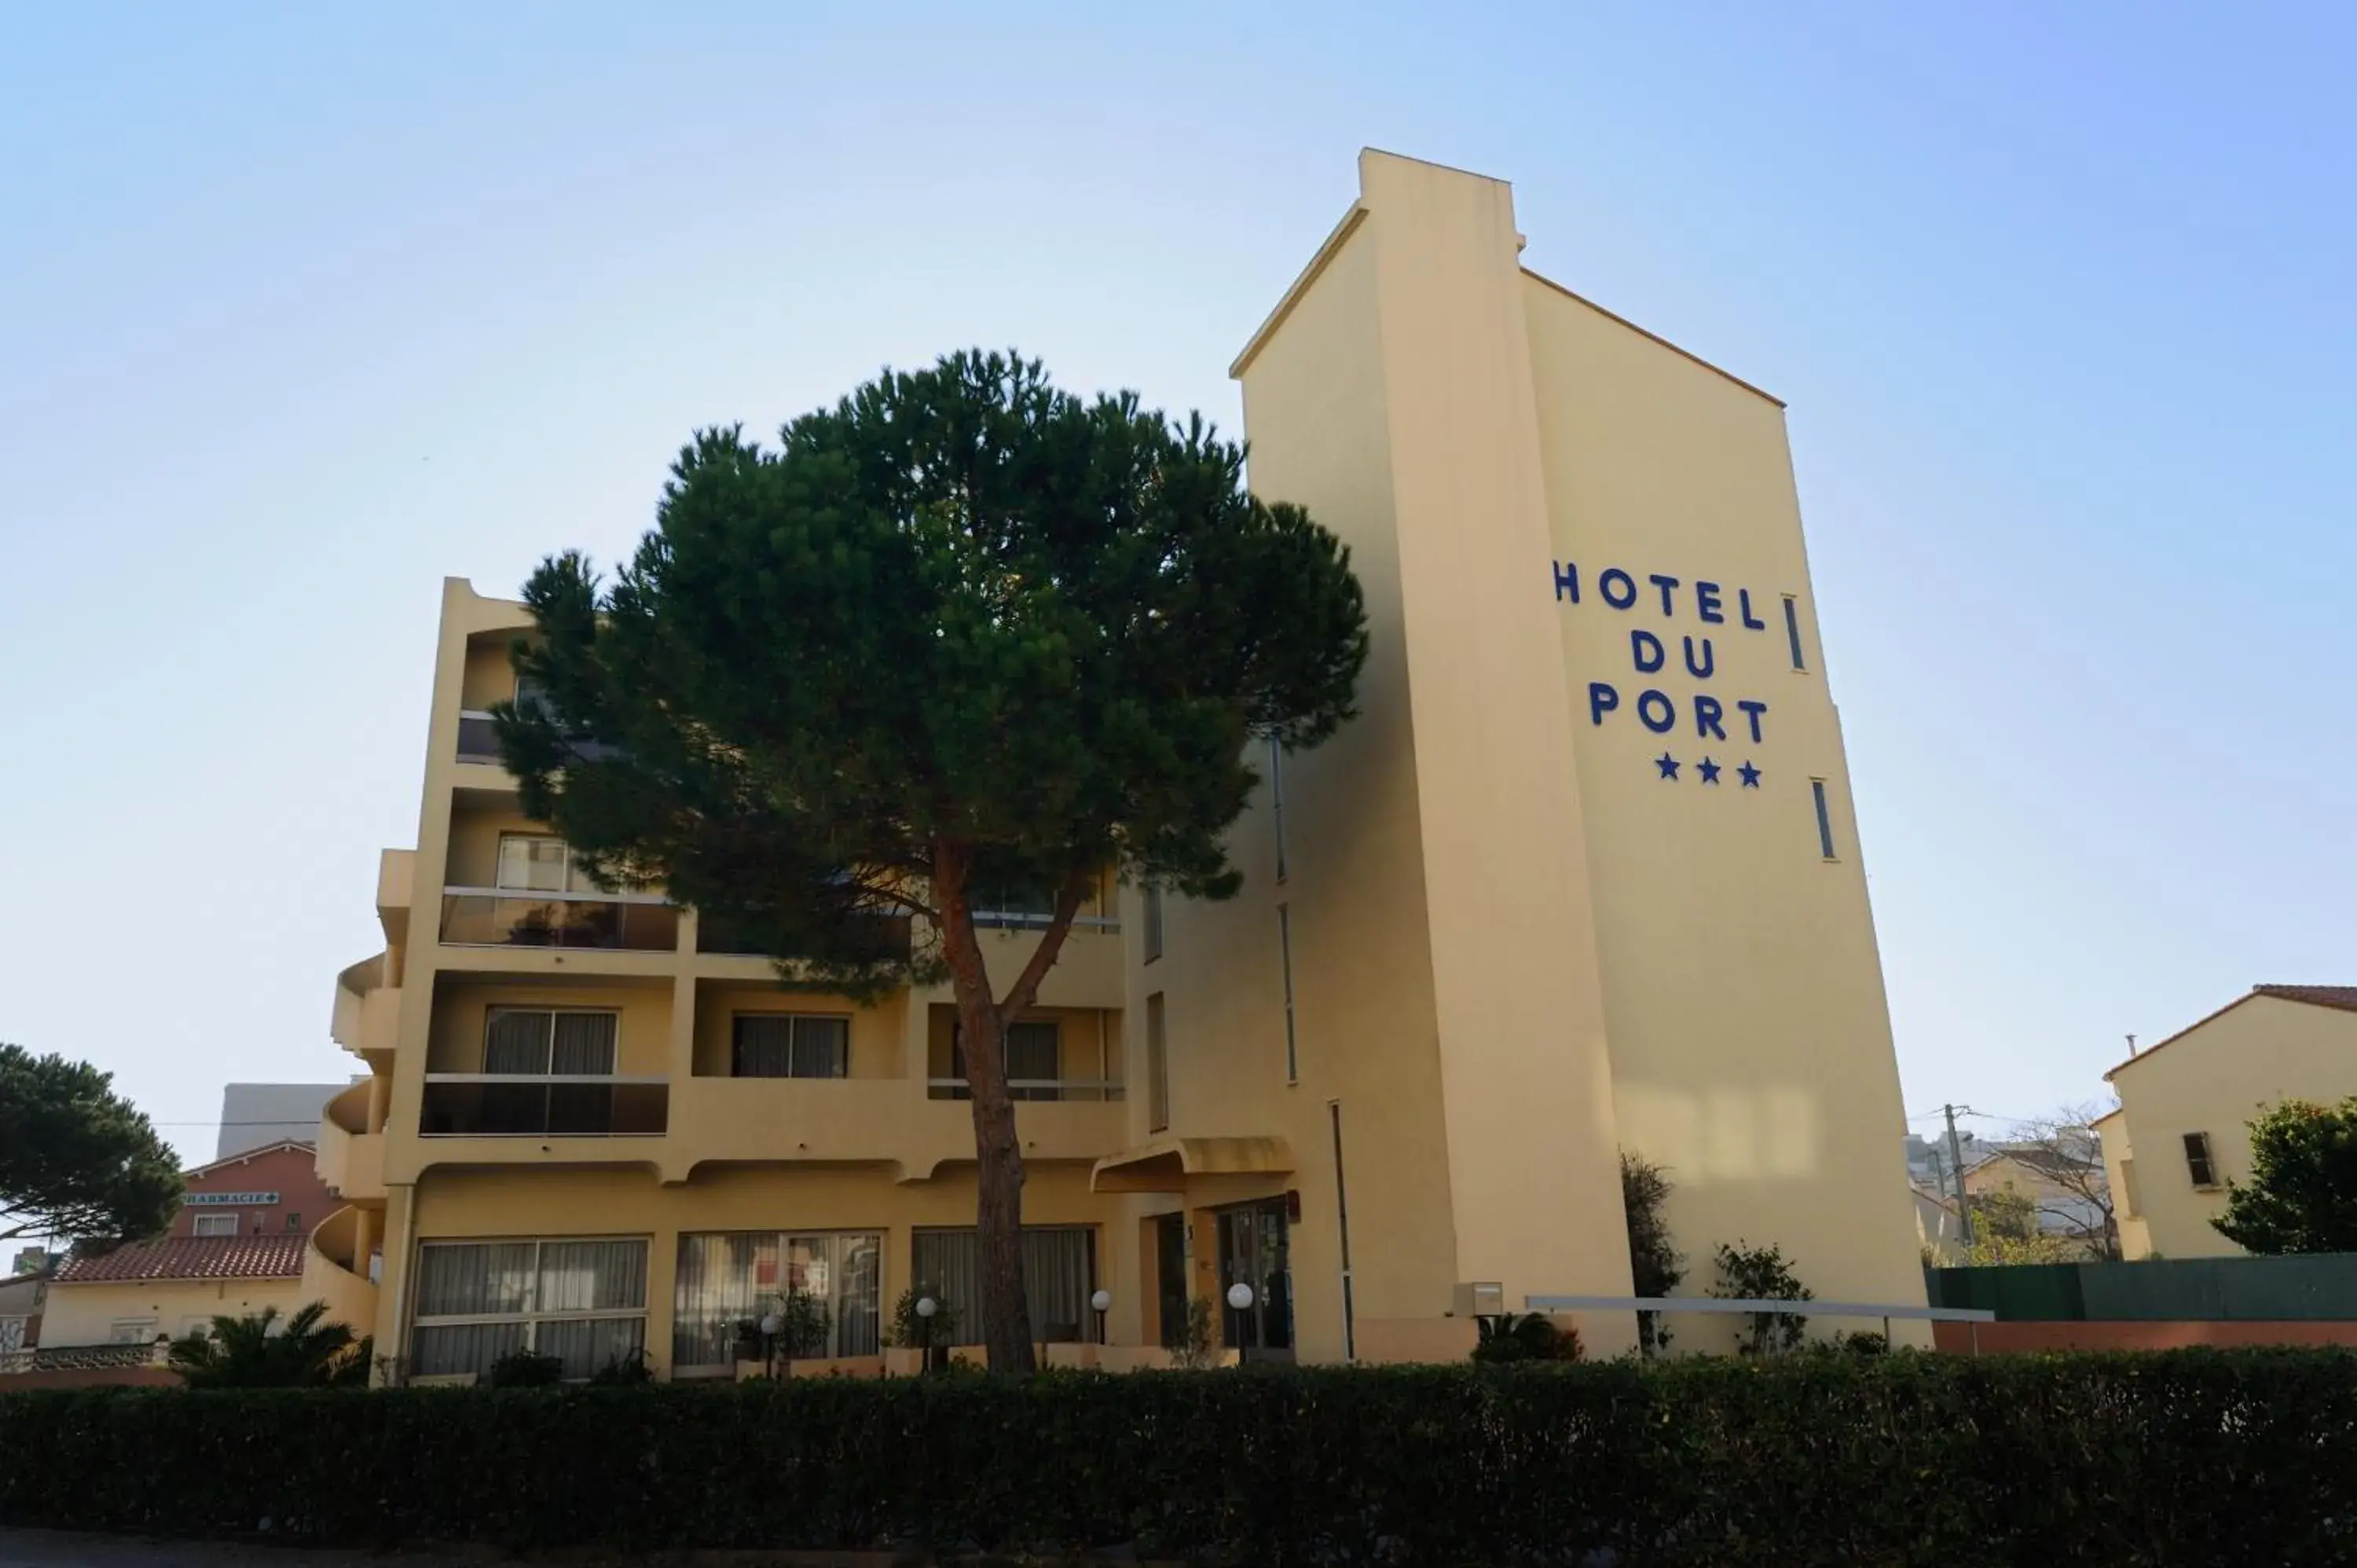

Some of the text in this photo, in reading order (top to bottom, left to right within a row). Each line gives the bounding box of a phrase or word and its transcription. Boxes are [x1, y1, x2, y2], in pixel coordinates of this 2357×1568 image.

[1552, 560, 1765, 630] HOTEL
[1630, 629, 1714, 678] DU
[1589, 682, 1767, 743] PORT
